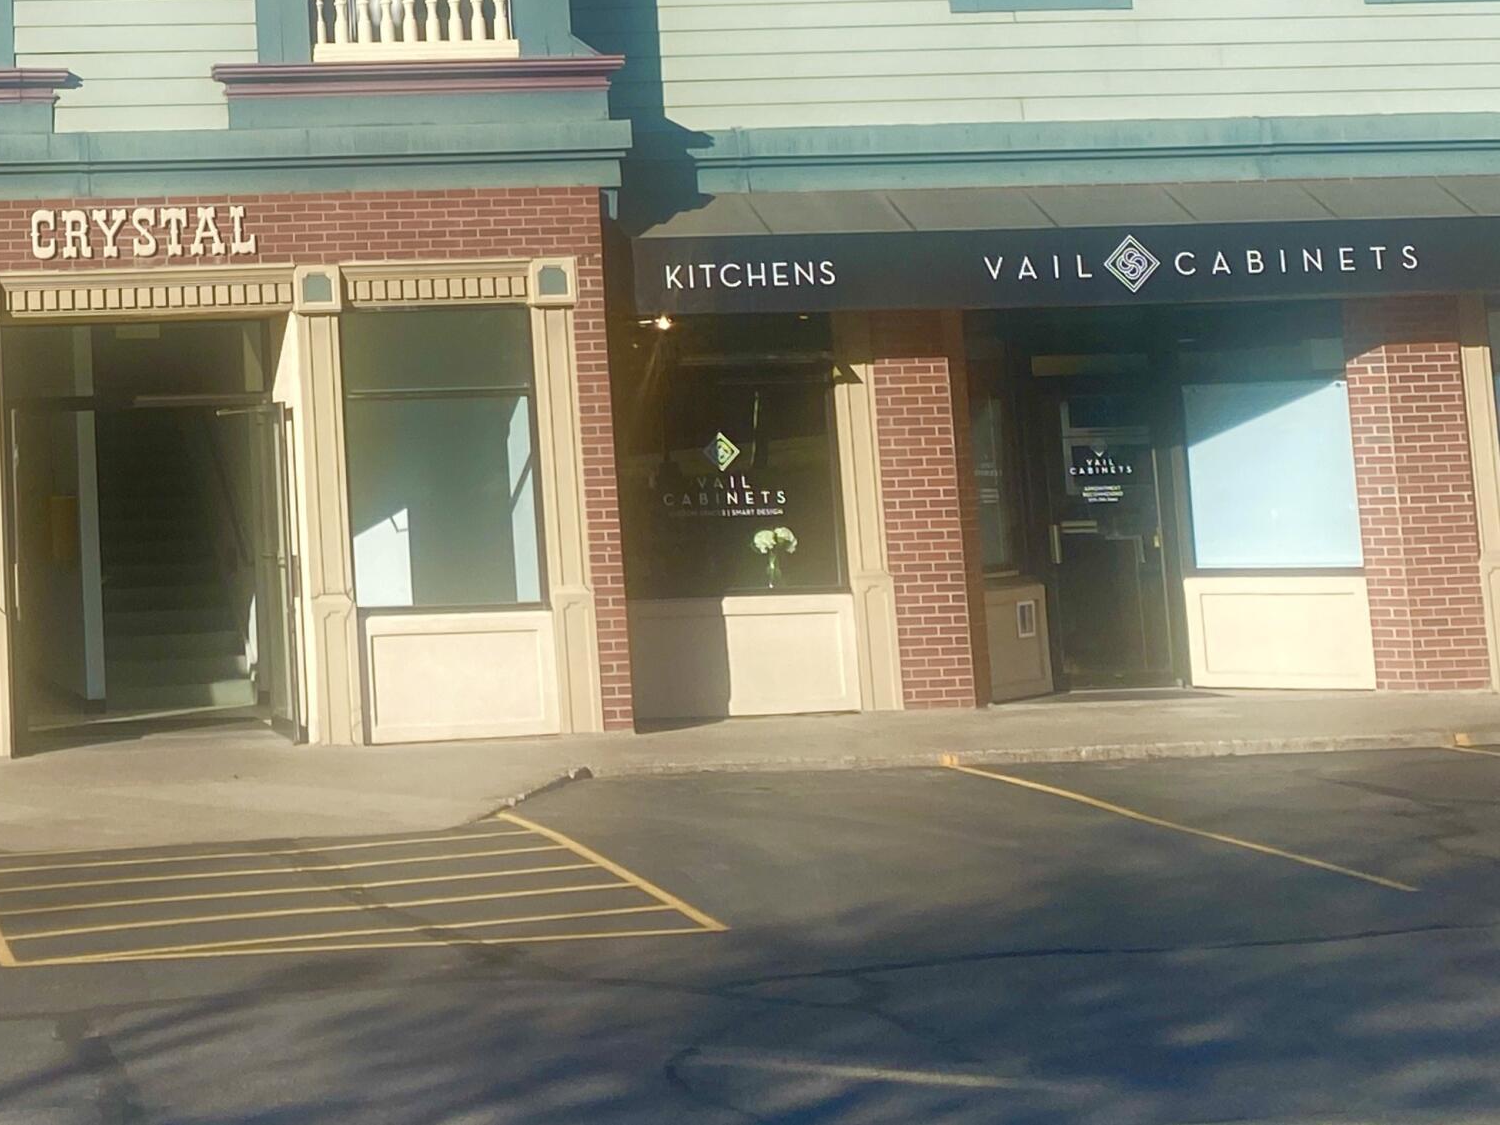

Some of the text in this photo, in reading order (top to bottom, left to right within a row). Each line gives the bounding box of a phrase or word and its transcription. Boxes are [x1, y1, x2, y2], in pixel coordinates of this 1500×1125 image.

[30, 205, 257, 259] CRYSTAL
[983, 245, 1419, 280] VAIL CABINETS
[665, 260, 836, 289] KITCHENS
[1069, 465, 1133, 475] CABINETS
[1085, 458, 1115, 466] VAIL
[697, 475, 751, 490] VAIL
[662, 490, 786, 507] CABINETS
